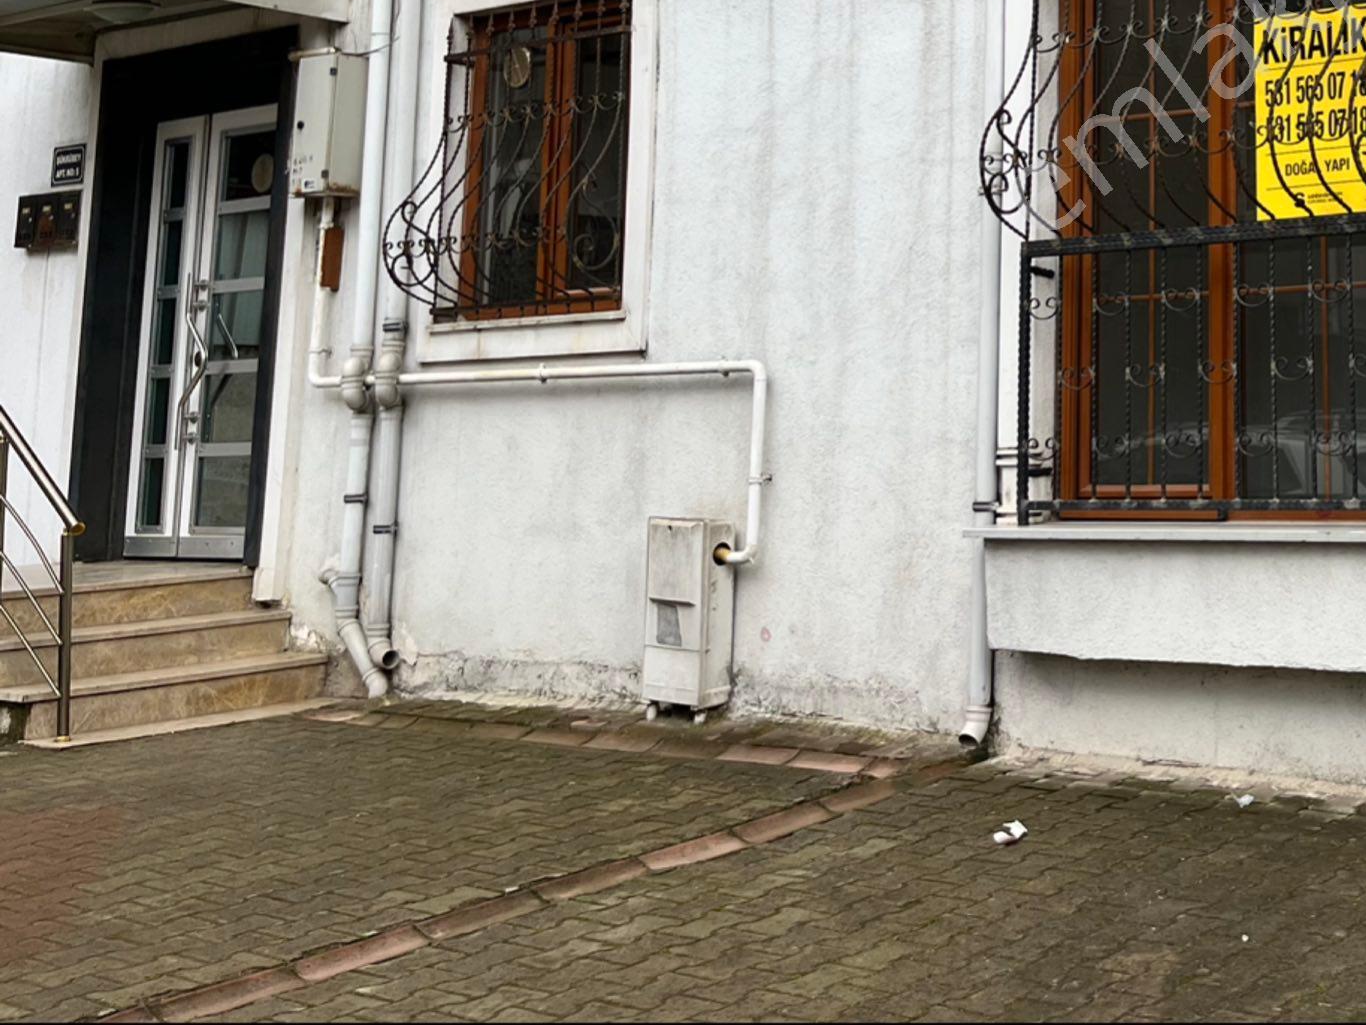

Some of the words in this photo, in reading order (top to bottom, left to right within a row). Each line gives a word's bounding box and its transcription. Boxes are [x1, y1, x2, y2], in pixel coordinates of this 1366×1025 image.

[1328, 72, 1345, 99] 07
[1297, 111, 1323, 140] 55
[1328, 107, 1346, 136] 07
[1285, 160, 1320, 176] DOĞA
[1324, 157, 1350, 172] YAPI
